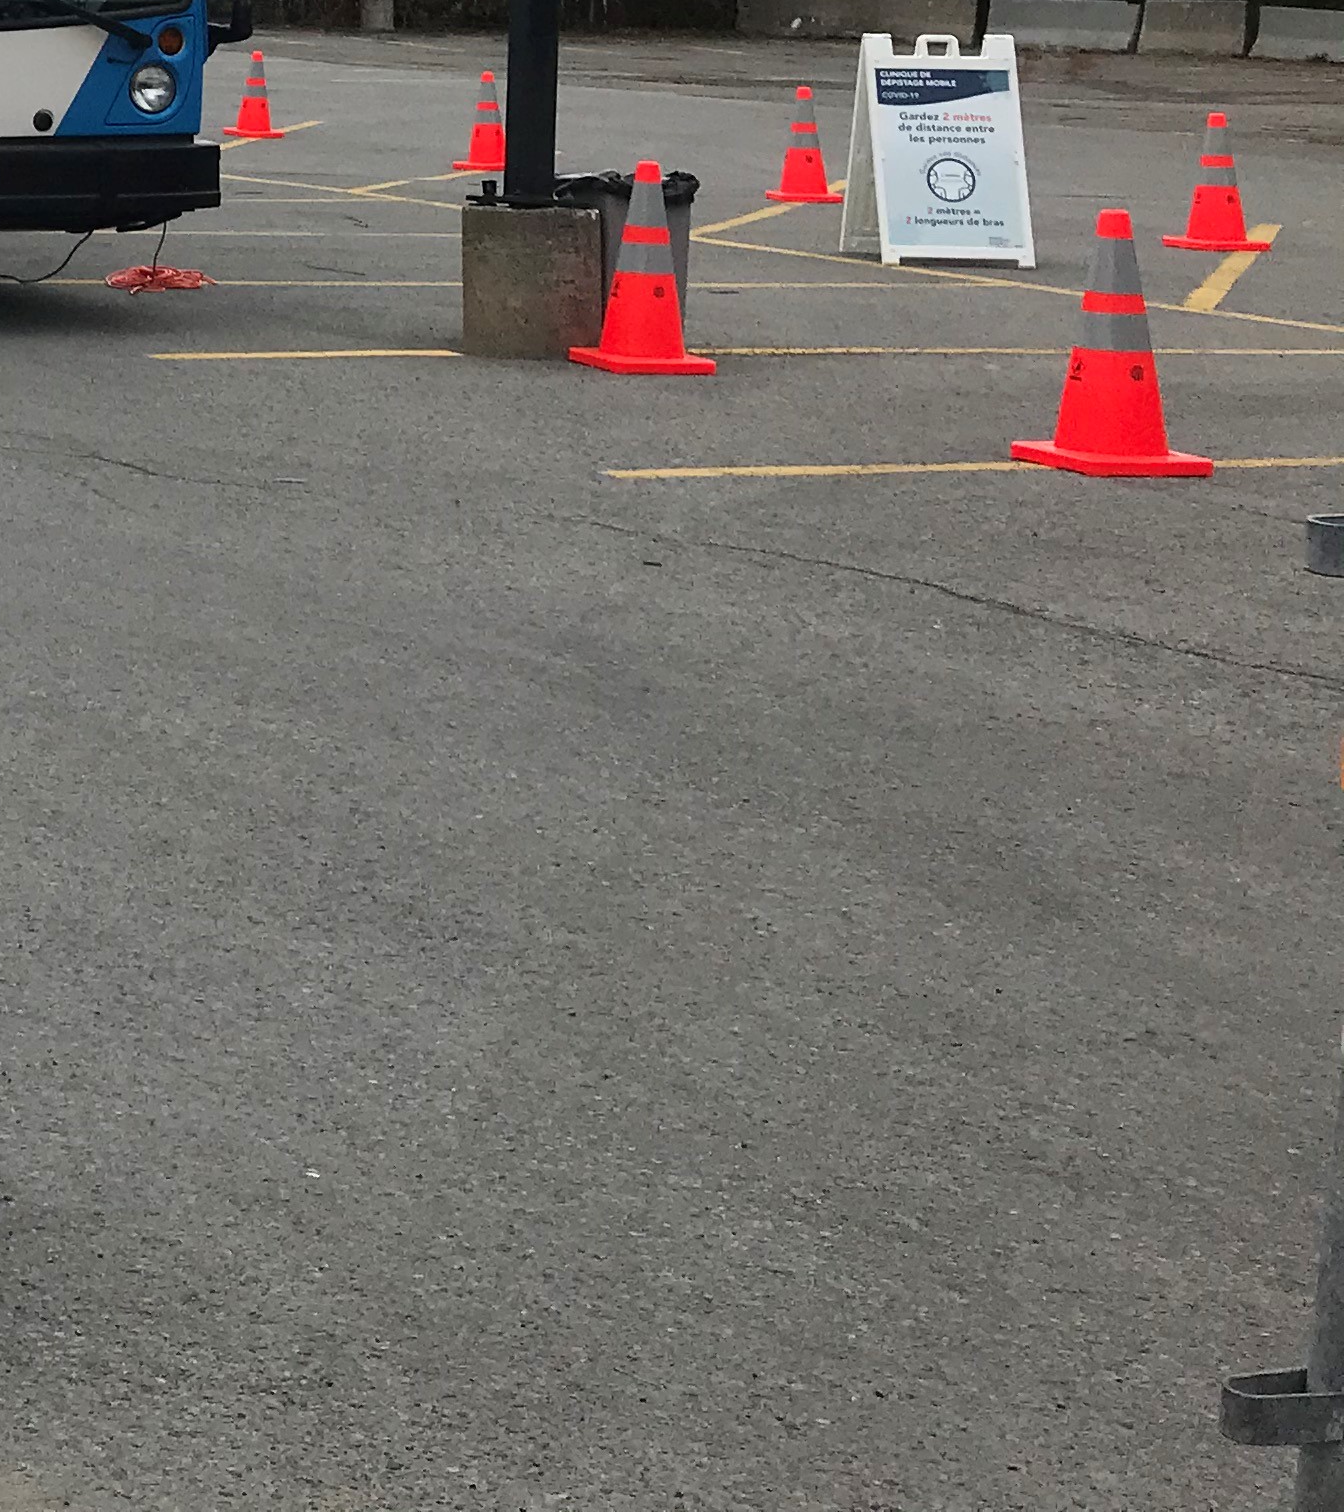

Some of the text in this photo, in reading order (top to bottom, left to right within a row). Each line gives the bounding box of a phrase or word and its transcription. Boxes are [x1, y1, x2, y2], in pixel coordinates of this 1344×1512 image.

[925, 79, 957, 87] MOBILE
[881, 91, 920, 99] COVID-19
[899, 111, 992, 122] Gardez 2 mètres
[898, 122, 995, 133] de distance entre
[909, 133, 986, 145] les personnes
[906, 215, 1005, 227] 2 longueurs de bras
